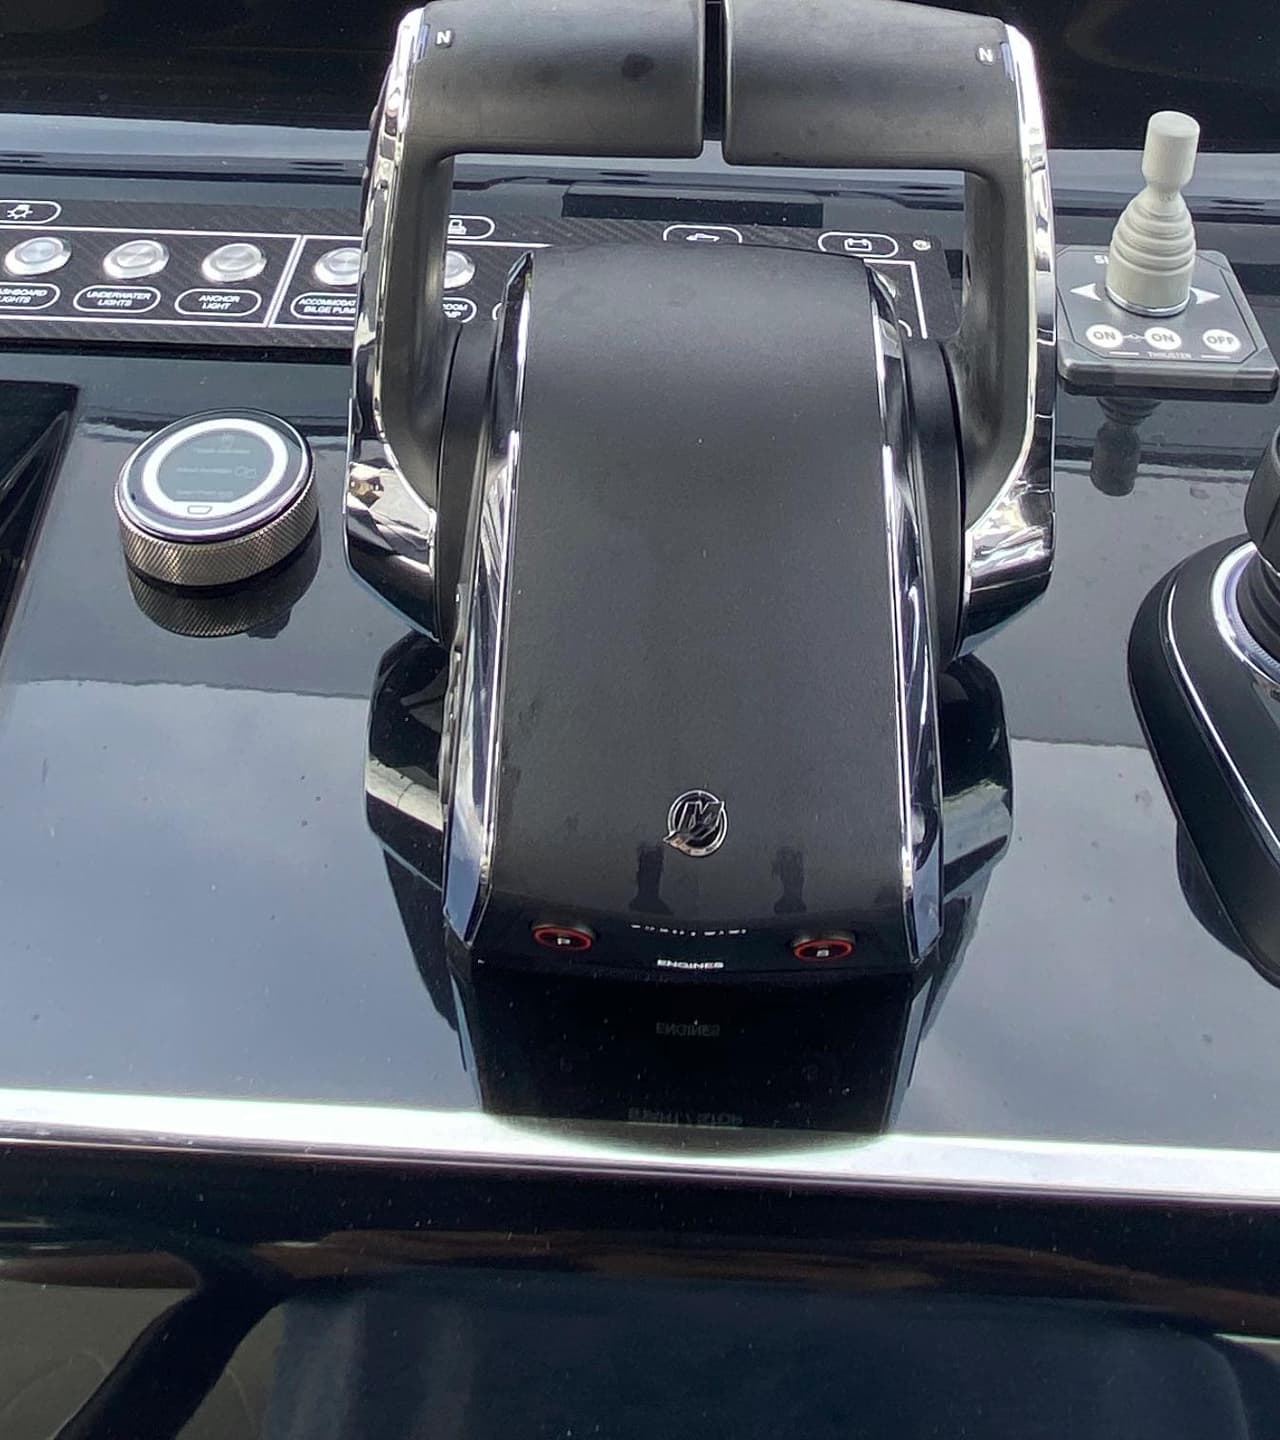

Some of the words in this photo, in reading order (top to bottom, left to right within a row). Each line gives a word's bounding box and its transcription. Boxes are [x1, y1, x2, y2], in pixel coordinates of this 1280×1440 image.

[435, 30, 452, 45] N
[978, 48, 993, 62] N
[86, 291, 152, 301] UNDERWATER
[198, 295, 241, 304] ANCHOR
[97, 298, 133, 307] LIGHTS
[201, 302, 232, 311] LIGHT
[298, 297, 357, 307] ACCOMMODAT
[332, 306, 356, 315] PUM
[1092, 329, 1117, 343] ON
[1151, 332, 1175, 345] ON
[1206, 334, 1235, 347] OFF
[656, 958, 725, 970] ENGINES
